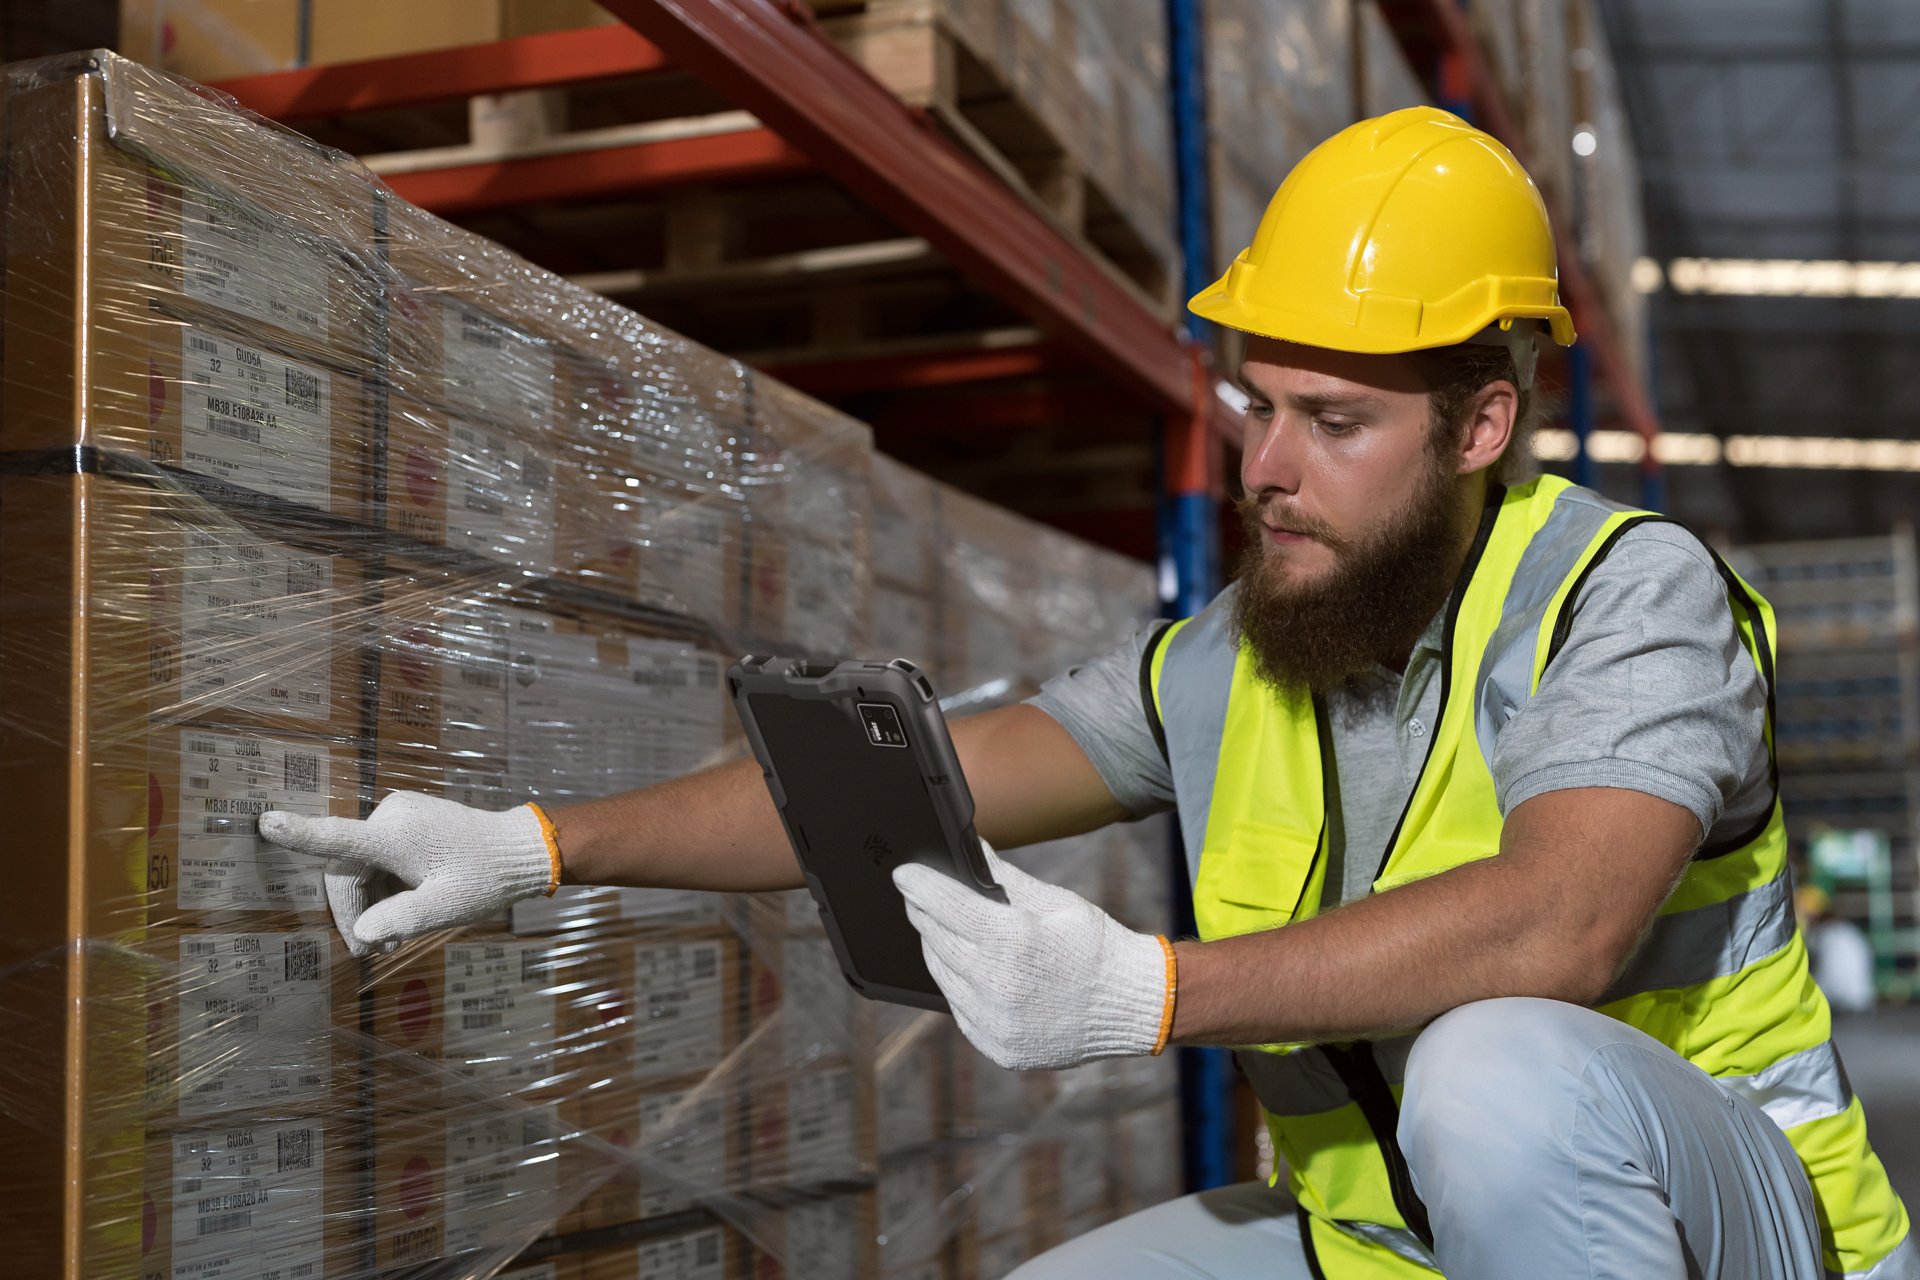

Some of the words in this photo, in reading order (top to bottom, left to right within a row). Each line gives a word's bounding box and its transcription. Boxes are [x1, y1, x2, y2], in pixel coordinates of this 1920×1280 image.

[210, 358, 221, 374] 32
[209, 758, 220, 773] 32
[147, 854, 169, 889] 50
[208, 959, 219, 974] 32
[226, 1132, 254, 1149] GUD6A
[201, 1157, 212, 1172] 32
